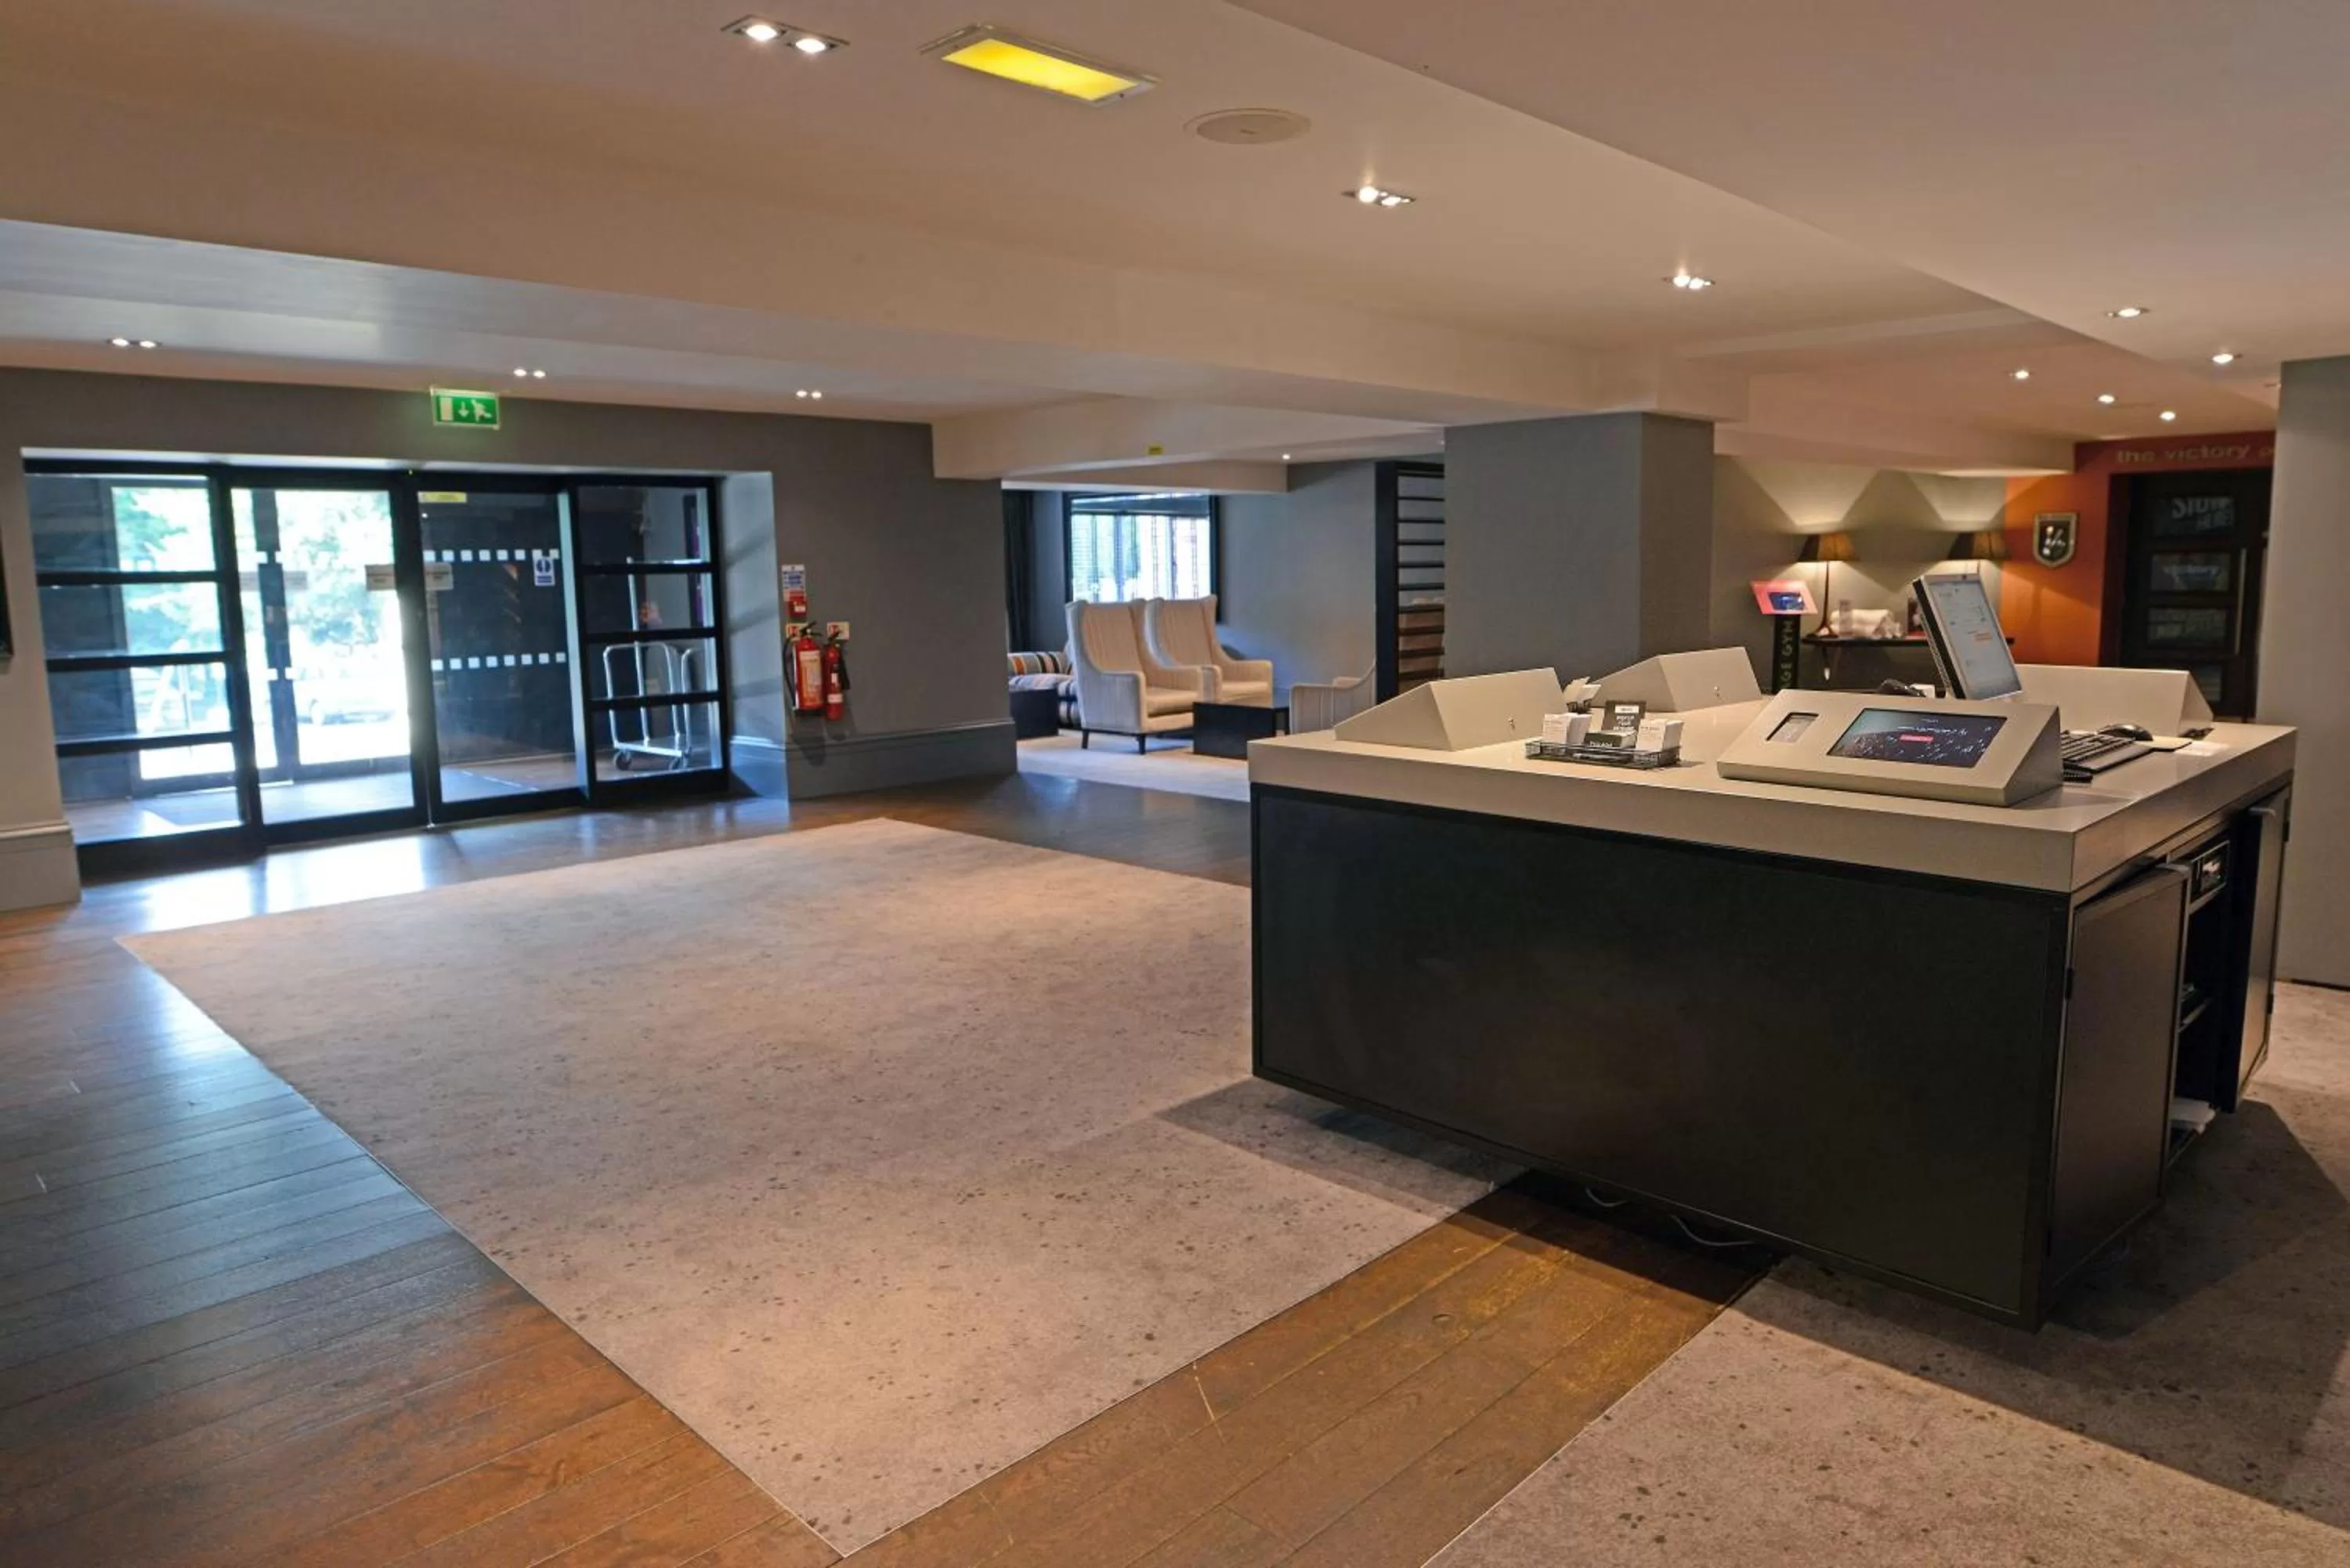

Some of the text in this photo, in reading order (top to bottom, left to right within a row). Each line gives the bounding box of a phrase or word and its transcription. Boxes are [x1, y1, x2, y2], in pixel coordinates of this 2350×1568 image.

[2117, 450, 2155, 463] the
[2165, 444, 2251, 461] victory
[1781, 620, 1793, 656] GYM
